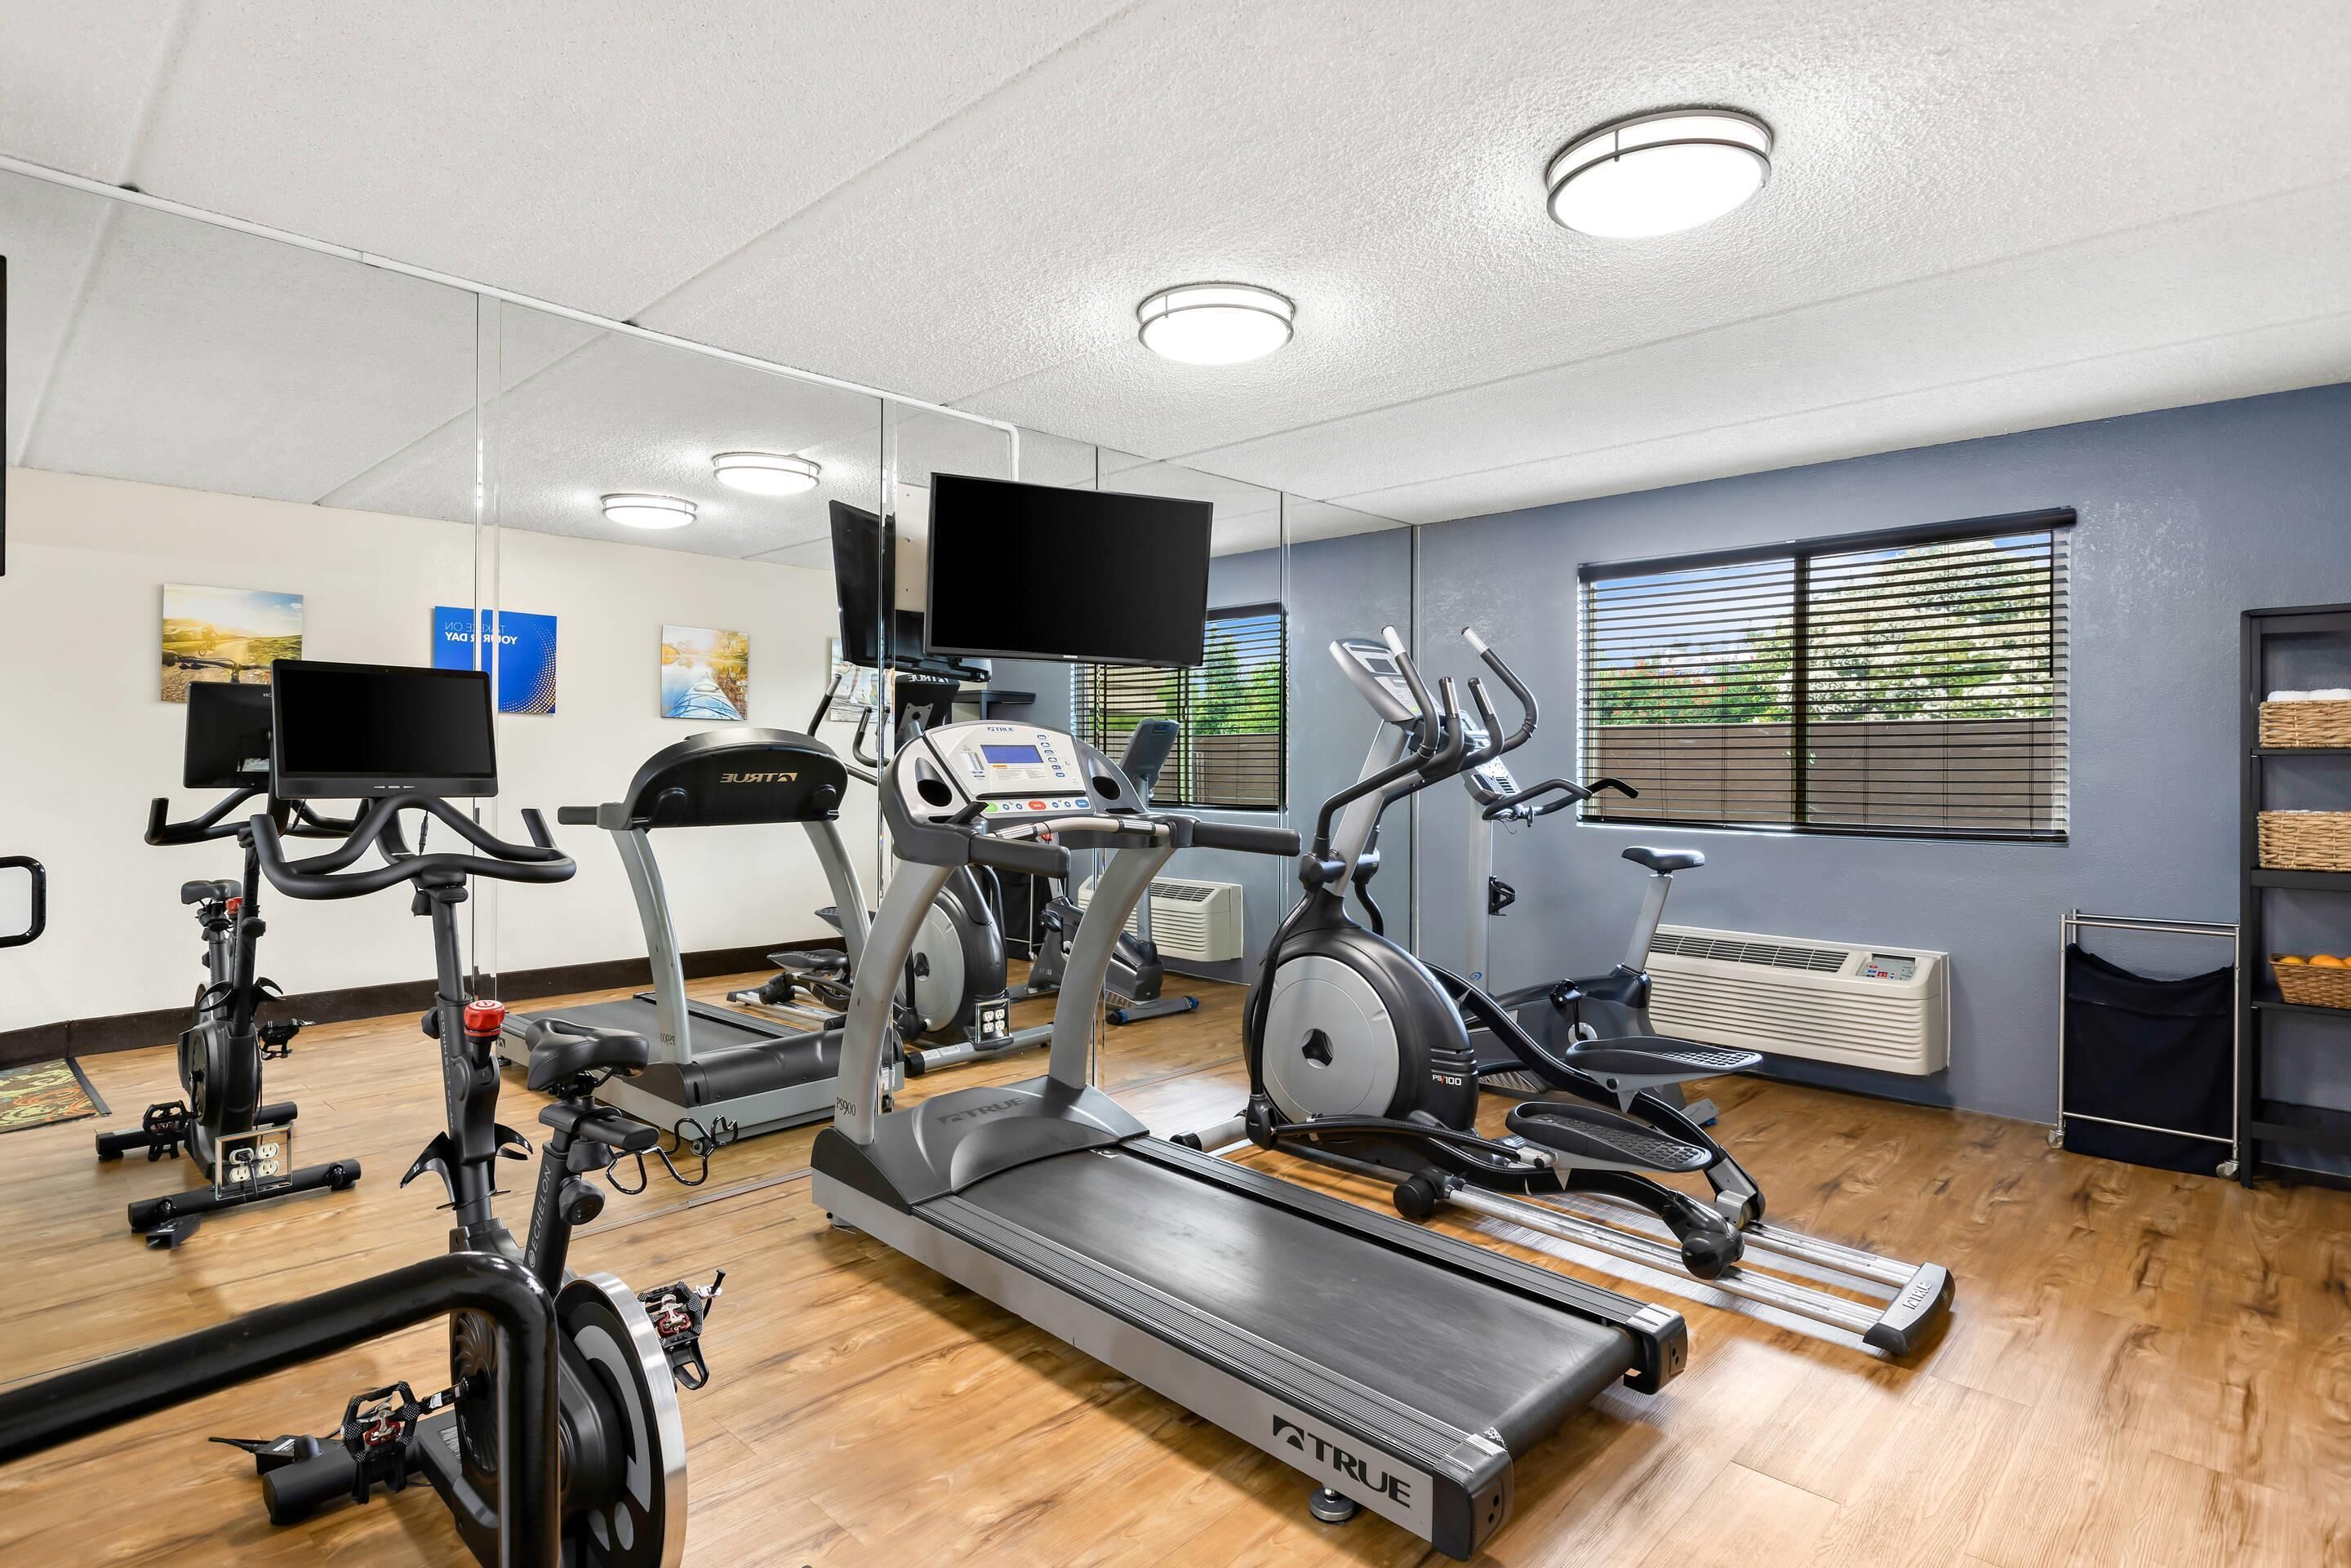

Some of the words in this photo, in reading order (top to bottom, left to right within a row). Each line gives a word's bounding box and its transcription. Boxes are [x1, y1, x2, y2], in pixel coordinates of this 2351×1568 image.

[440, 1011, 451, 1086] CONNECT
[1432, 1074, 1462, 1086] PS/100
[836, 1096, 856, 1117] PS900
[960, 1097, 1026, 1117] TRUE
[531, 1164, 552, 1254] ECHELON
[1306, 1433, 1411, 1508] TRUE
